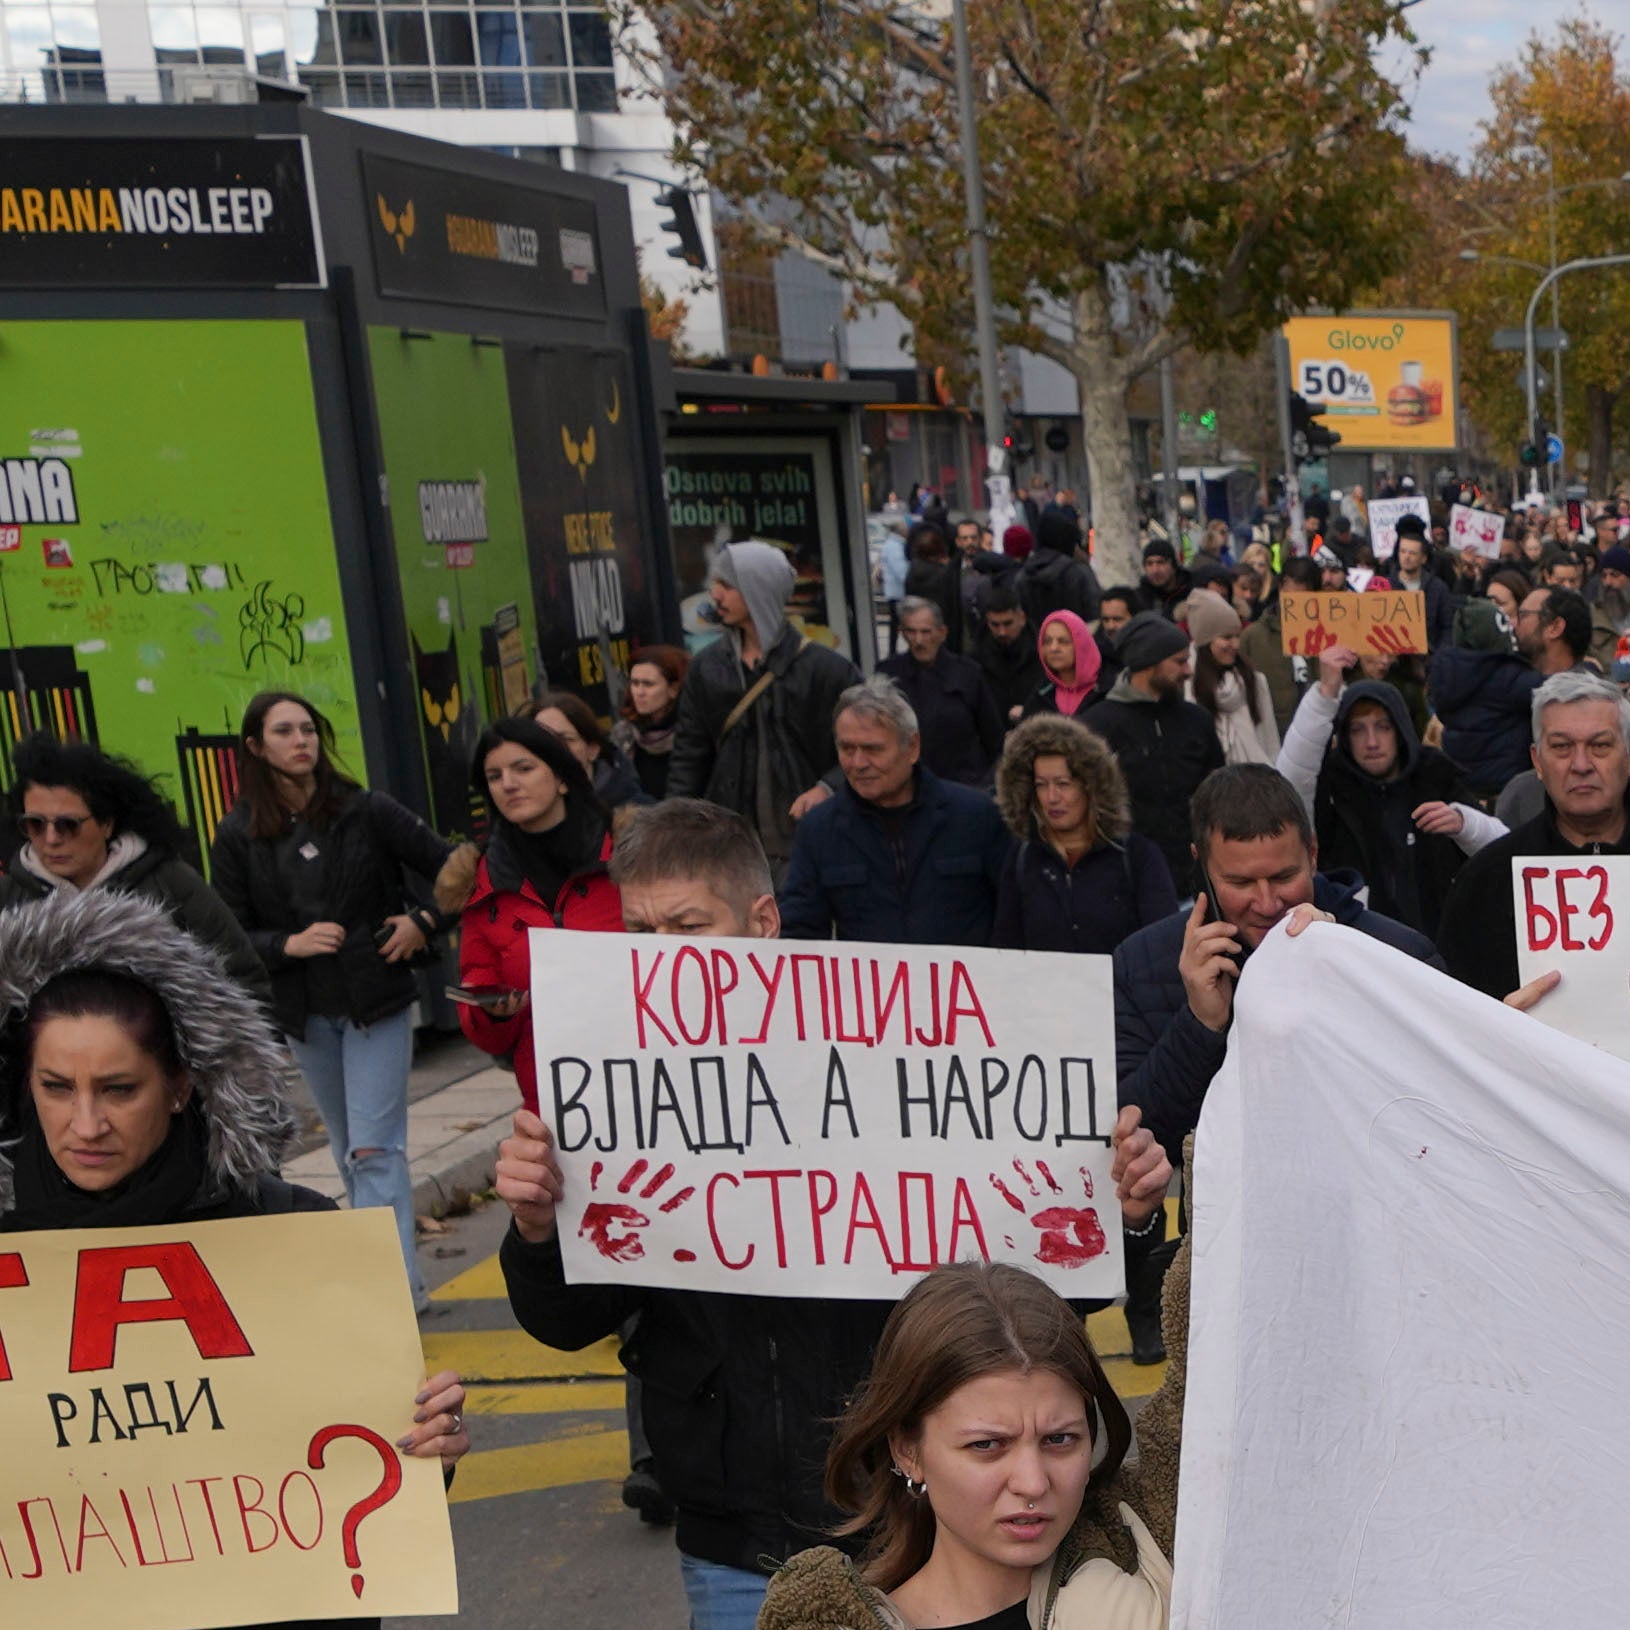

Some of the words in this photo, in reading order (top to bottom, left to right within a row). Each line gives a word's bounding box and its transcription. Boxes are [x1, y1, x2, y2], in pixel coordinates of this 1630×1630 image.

[1328, 330, 1395, 351] Glovo
[1305, 366, 1370, 396] 50%
[665, 465, 751, 494] Osnova
[761, 465, 810, 492] svih
[669, 497, 746, 526] dobrih
[754, 500, 806, 532] jela!
[569, 558, 624, 640] NIKAD
[1284, 597, 1422, 623] ROBIJA!
[1522, 866, 1614, 951] БЕЗ
[631, 945, 996, 1048] КОРУПЦИЈА
[550, 1053, 791, 1154] ВЛАДА
[821, 1045, 860, 1138] А
[897, 1054, 1110, 1147] НАРОД
[706, 1170, 992, 1275] СТРАДА
[47, 1377, 225, 1447] РАДИ
